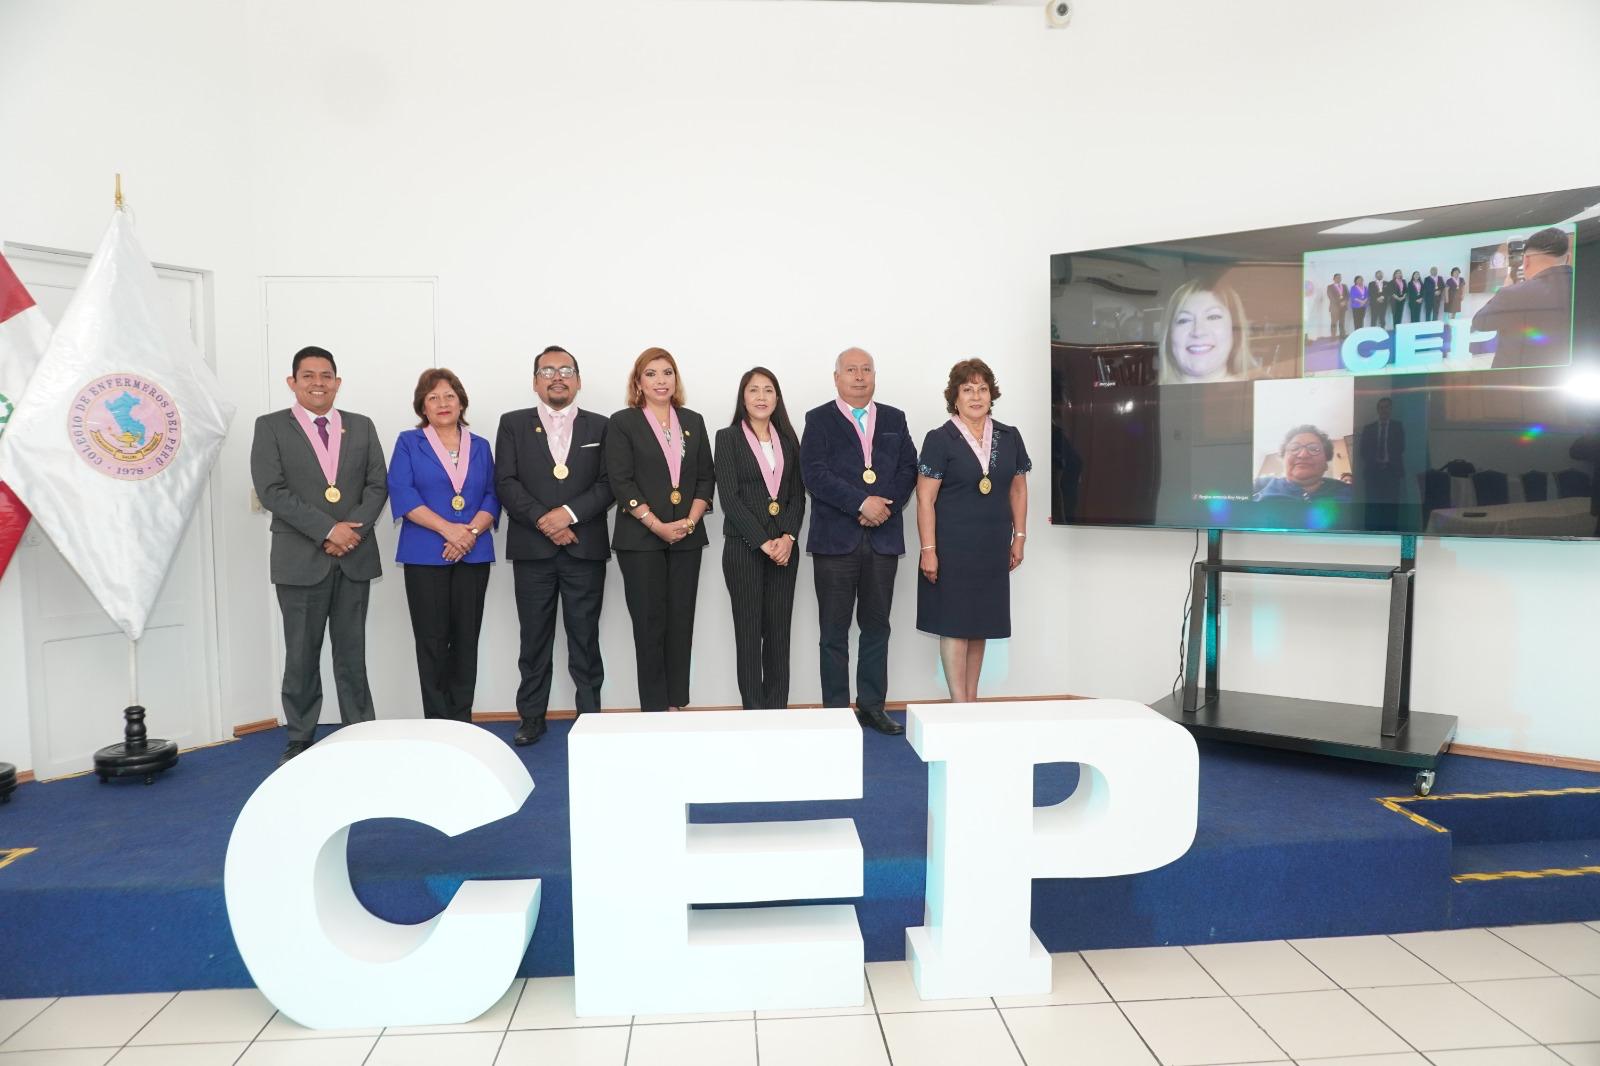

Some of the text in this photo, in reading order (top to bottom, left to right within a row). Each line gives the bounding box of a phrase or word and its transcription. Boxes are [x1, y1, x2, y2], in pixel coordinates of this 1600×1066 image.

[75, 395, 91, 411] DE
[90, 378, 169, 408] ENFERMEROS
[166, 411, 177, 433] DEL
[72, 415, 102, 465] COLEGIO
[116, 467, 144, 475] 1978
[224, 699, 1199, 1030] CEP
